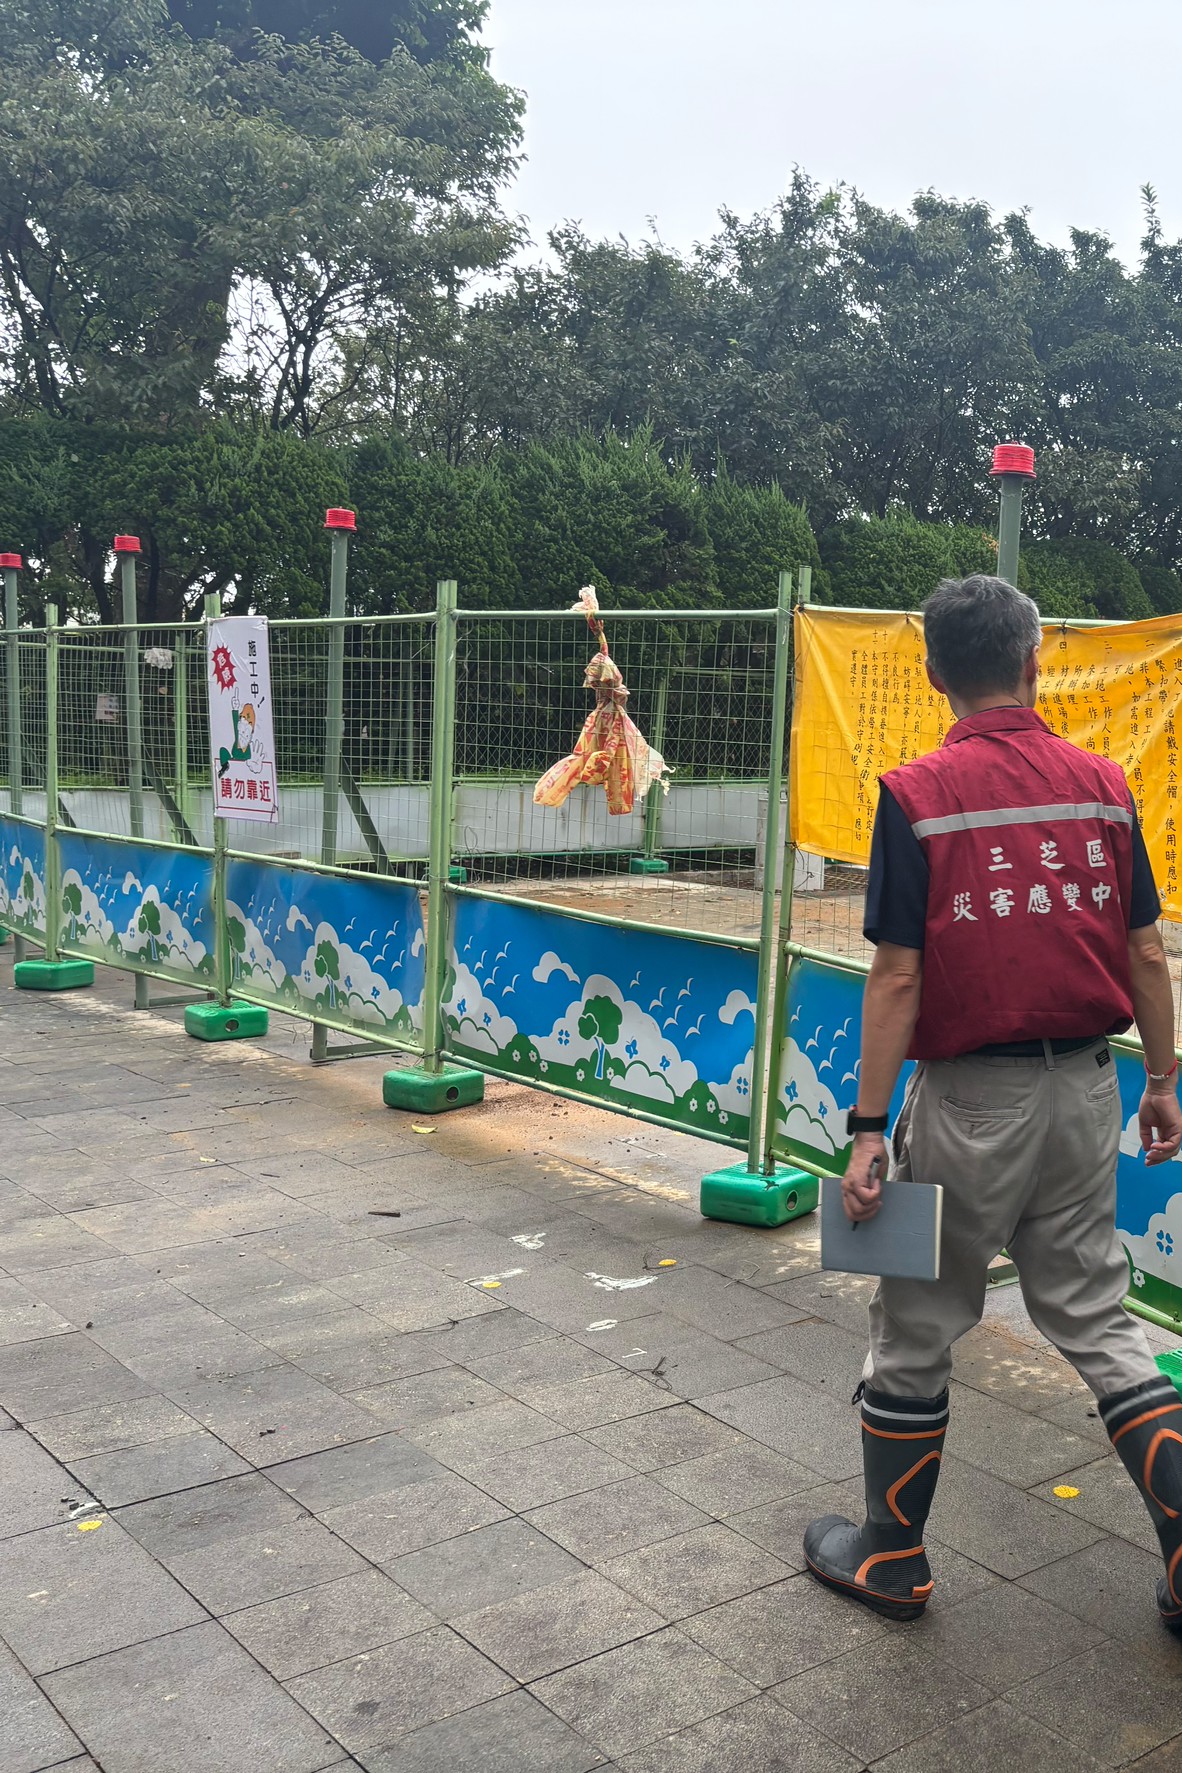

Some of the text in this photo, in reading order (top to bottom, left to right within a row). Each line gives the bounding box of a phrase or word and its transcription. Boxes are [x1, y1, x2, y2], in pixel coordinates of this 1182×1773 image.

[220, 777, 271, 803] 請勿靠近
[987, 839, 1108, 872] 三芝區
[953, 881, 1121, 922] 災害應變中
